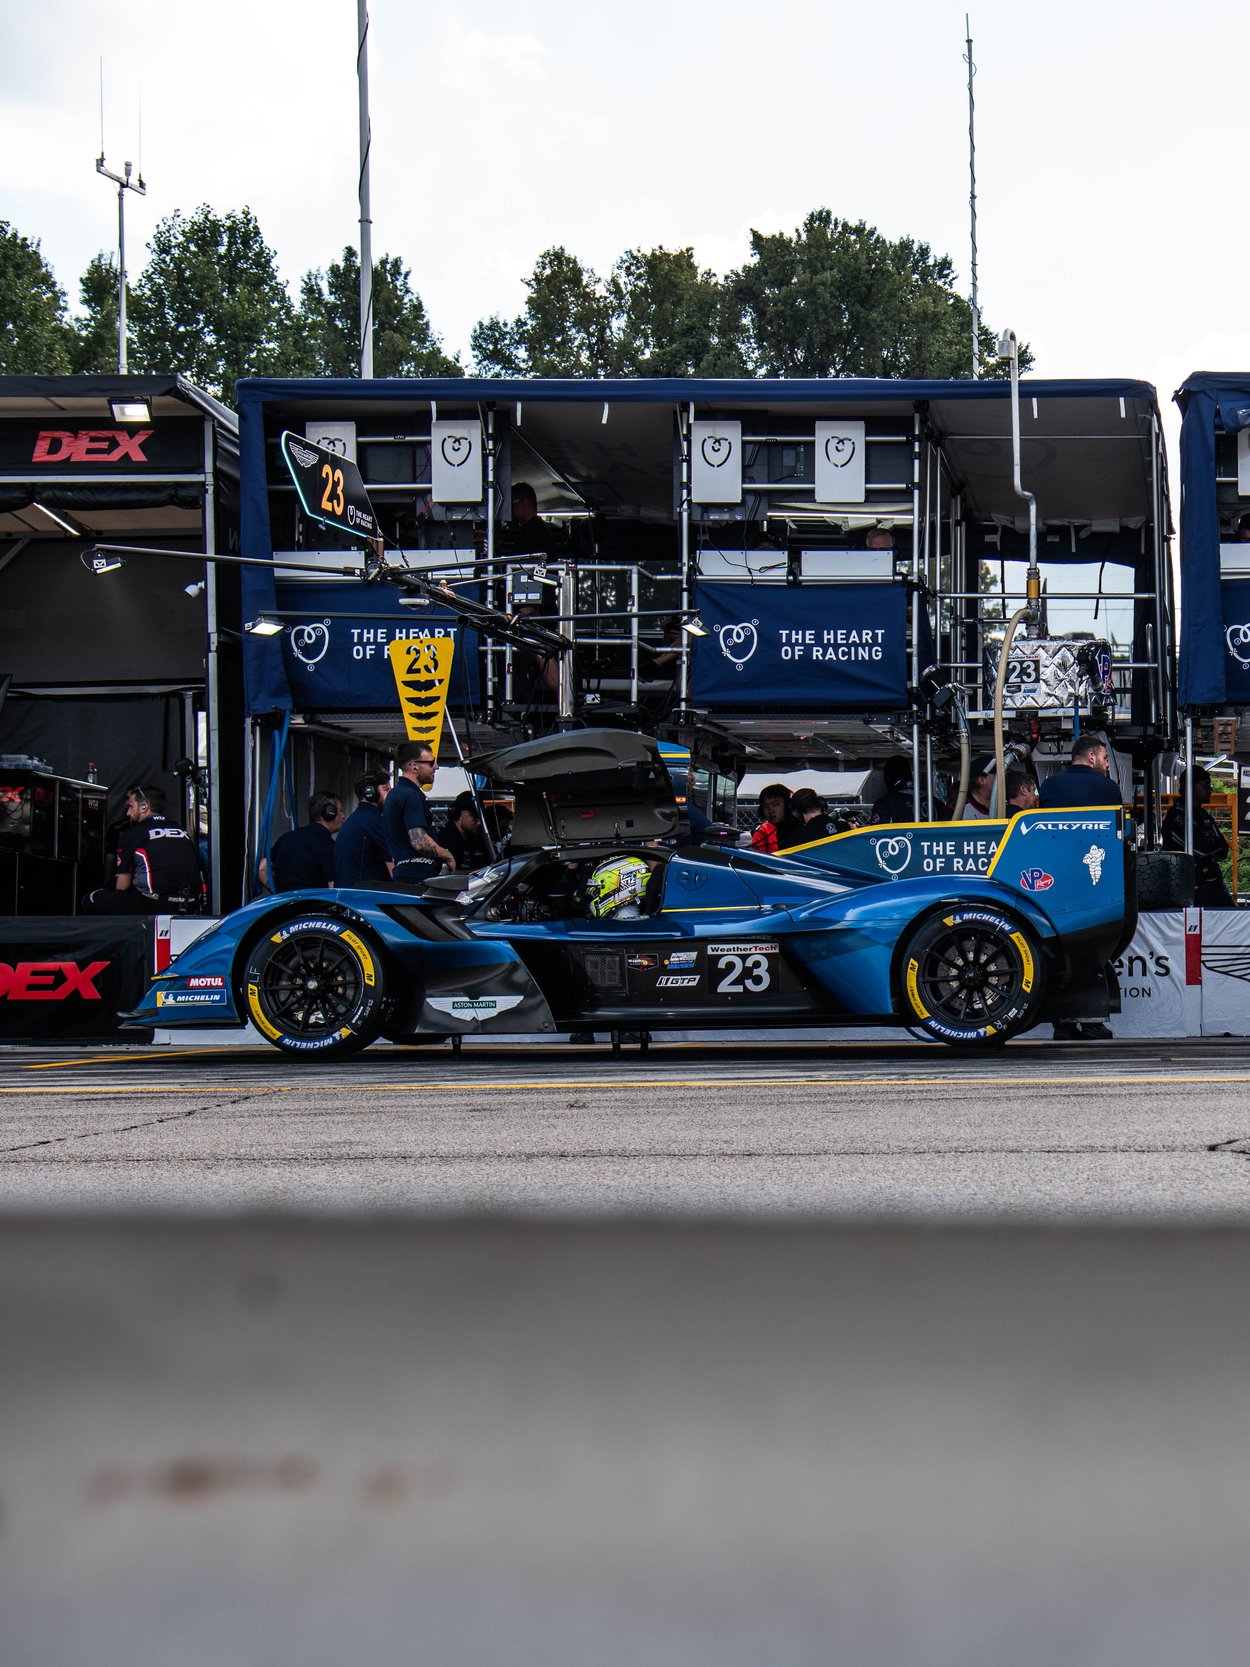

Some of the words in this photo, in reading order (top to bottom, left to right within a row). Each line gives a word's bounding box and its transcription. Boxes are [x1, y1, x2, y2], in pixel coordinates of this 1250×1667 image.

[31, 430, 154, 462] DEX
[321, 464, 344, 516] 23
[351, 629, 388, 643] THE
[779, 630, 815, 644] THE
[823, 630, 885, 644] HEART
[353, 645, 376, 659] OF
[406, 644, 439, 674] 23
[781, 646, 804, 660] OF
[812, 646, 883, 661] RACING
[1008, 660, 1036, 683] 23
[148, 828, 190, 840] DEX
[1020, 821, 1112, 835] VALKYRIE
[921, 841, 956, 855] THE
[963, 841, 998, 855] HEA
[923, 858, 946, 872] OF
[953, 858, 993, 872] RAC
[1021, 868, 1043, 890] VP
[289, 921, 341, 934] MICHELIN
[963, 912, 1012, 931] MICHELIN
[346, 933, 359, 946] PILOT
[356, 945, 368, 960] SPORT
[710, 944, 777, 953] WeatherTech
[0, 961, 111, 999] EX
[669, 977, 697, 985] GTP
[717, 955, 771, 993] 23
[189, 977, 223, 987] MOTUL
[176, 993, 221, 1002] MICHELIN
[1120, 987, 1151, 998] ION
[928, 1019, 977, 1039] MICHELIN
[283, 1037, 334, 1049] MICHELIN
